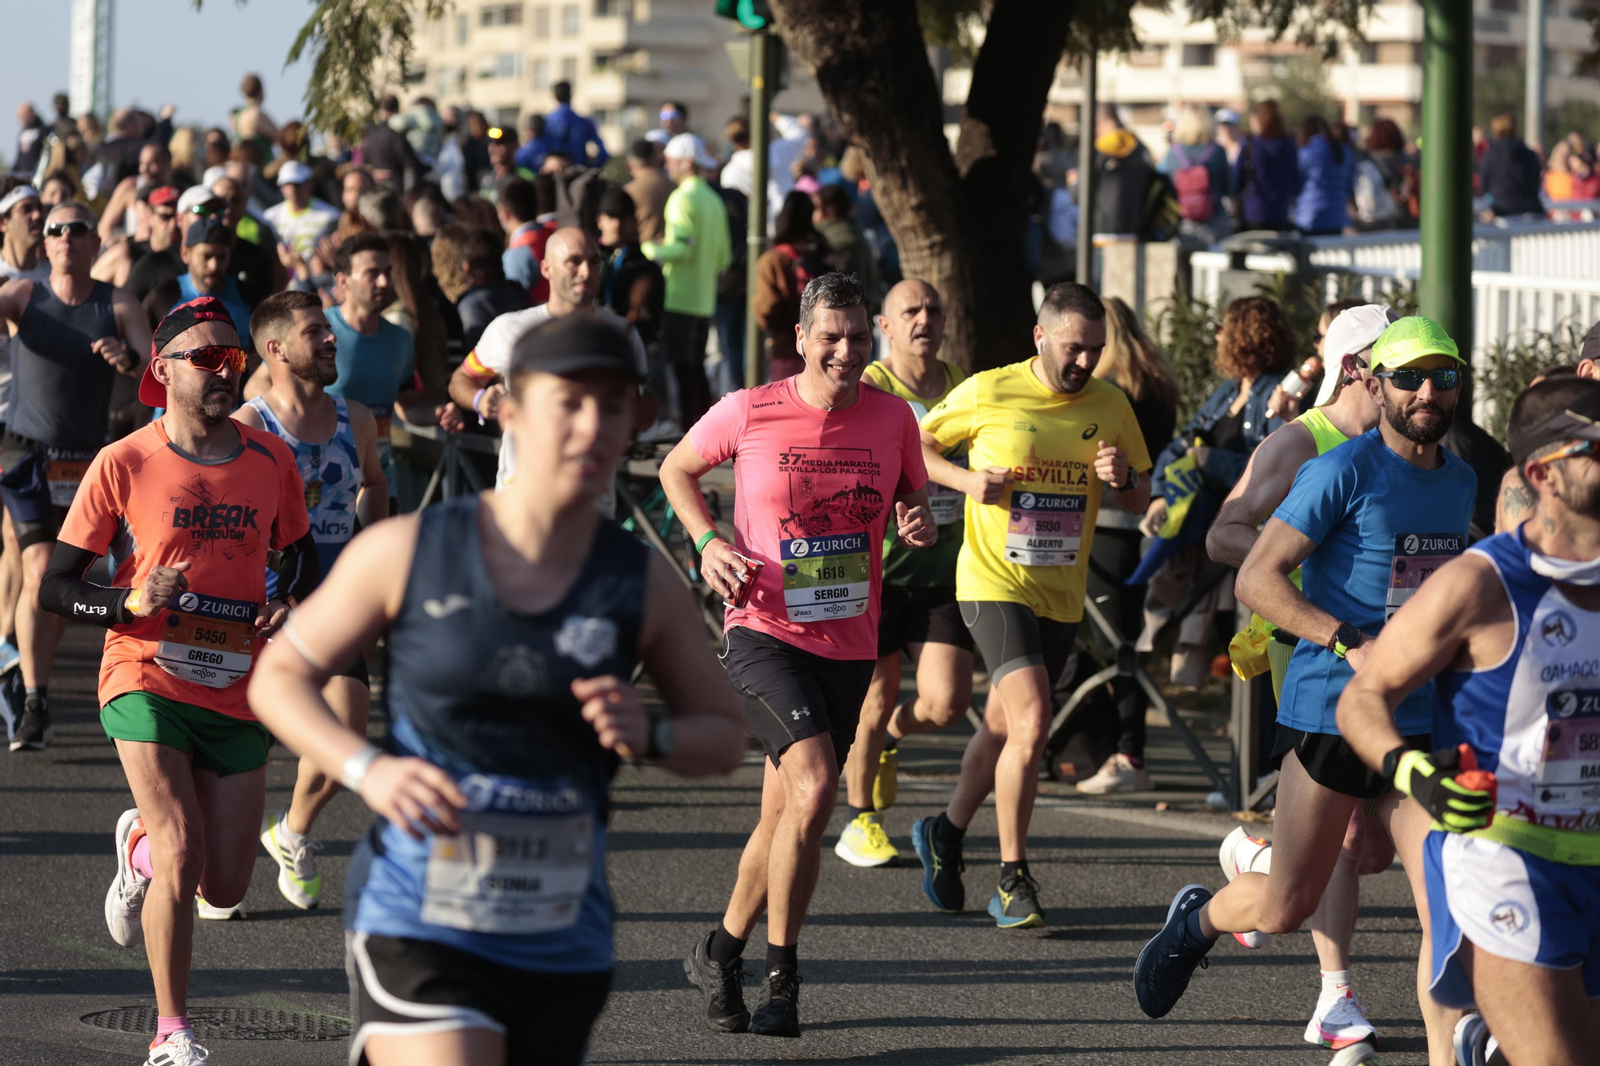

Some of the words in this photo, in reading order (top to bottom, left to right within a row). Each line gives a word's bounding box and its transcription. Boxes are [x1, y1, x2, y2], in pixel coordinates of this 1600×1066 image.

[752, 401, 776, 409] luanvi
[802, 459, 833, 467] MEDIA
[840, 466, 881, 476] PALACIOS
[1037, 498, 1080, 509] ZURICH
[172, 504, 259, 530] BREAK
[1035, 520, 1061, 532] 5930
[190, 529, 245, 541] THROUGH
[812, 537, 861, 553] ZURICH
[1026, 538, 1064, 549] ALBERTO
[1421, 538, 1460, 551] ZURICH
[816, 566, 846, 581] 1618
[814, 587, 849, 600] SERGIO
[201, 600, 250, 618] ZURICH
[194, 627, 227, 645] 5450
[188, 649, 223, 665] GREGO
